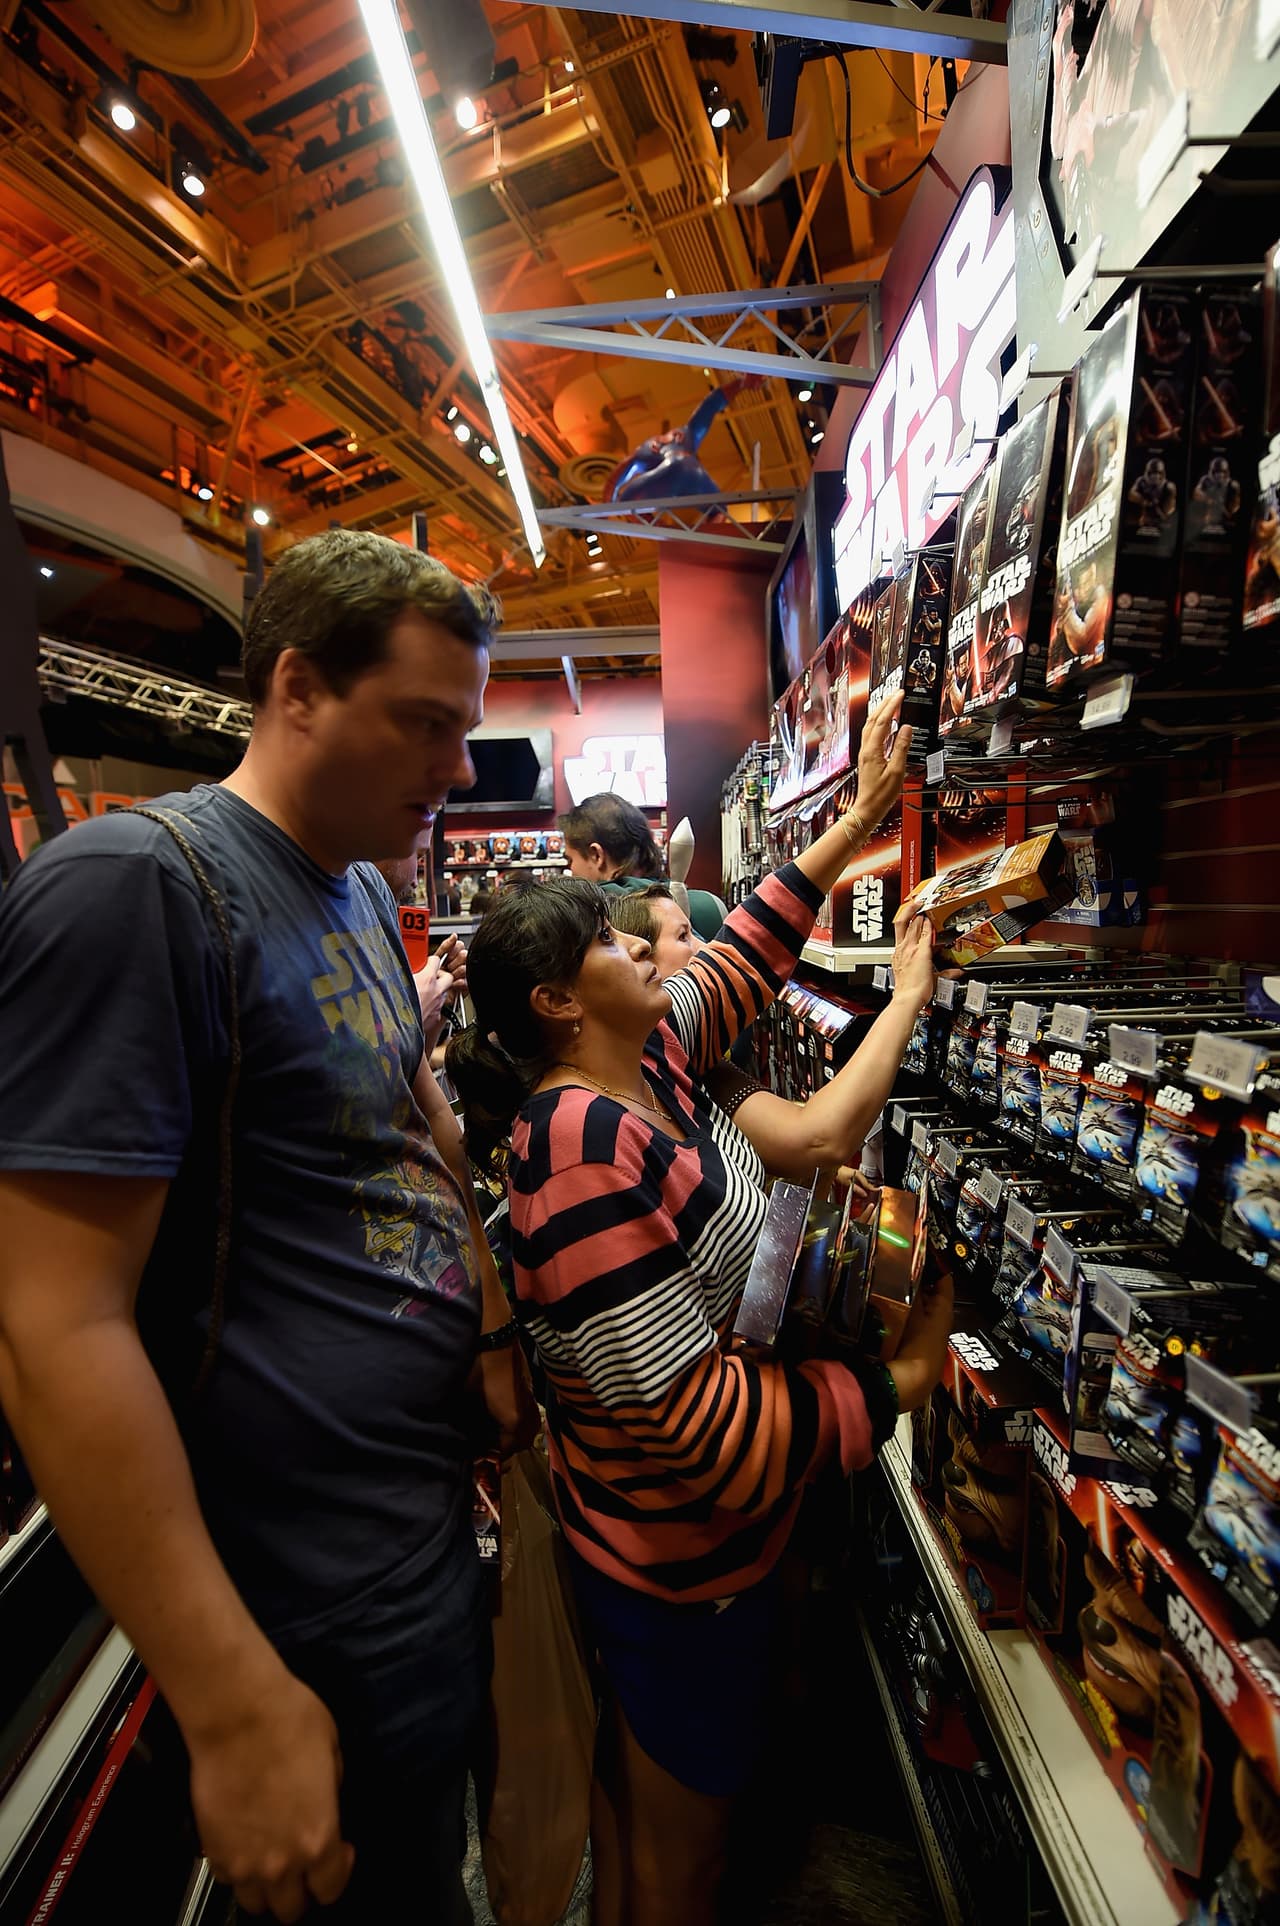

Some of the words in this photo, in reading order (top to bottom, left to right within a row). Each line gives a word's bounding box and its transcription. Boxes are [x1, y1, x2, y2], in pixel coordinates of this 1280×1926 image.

[835, 181, 1016, 552] STAR
[1066, 492, 1114, 540] STAR
[1059, 514, 1113, 569] WARS
[987, 554, 1032, 591] STAR
[980, 570, 1031, 614] WARS
[581, 735, 667, 773] STA
[563, 756, 667, 807] WA
[403, 912, 426, 931] 03
[853, 875, 872, 942] STAR
[867, 876, 884, 942] WARS
[1007, 1037, 1029, 1049] STAR
[1059, 1025, 1073, 1037] 2.99
[1005, 1044, 1029, 1056] WARS
[1049, 1058, 1082, 1073] WARS
[1050, 1050, 1081, 1064] STAR
[1094, 1071, 1127, 1088] WARS
[1157, 1085, 1194, 1106] STAR
[1155, 1095, 1195, 1117] WARS
[982, 1187, 993, 1201] 2.99
[1012, 1220, 1024, 1234] 2.99
[949, 1333, 992, 1371] WARS
[956, 1332, 1000, 1371] STAR
[1004, 1410, 1033, 1427] ST
[1033, 1426, 1077, 1496] WARS
[72, 1808, 97, 1849] Hologram
